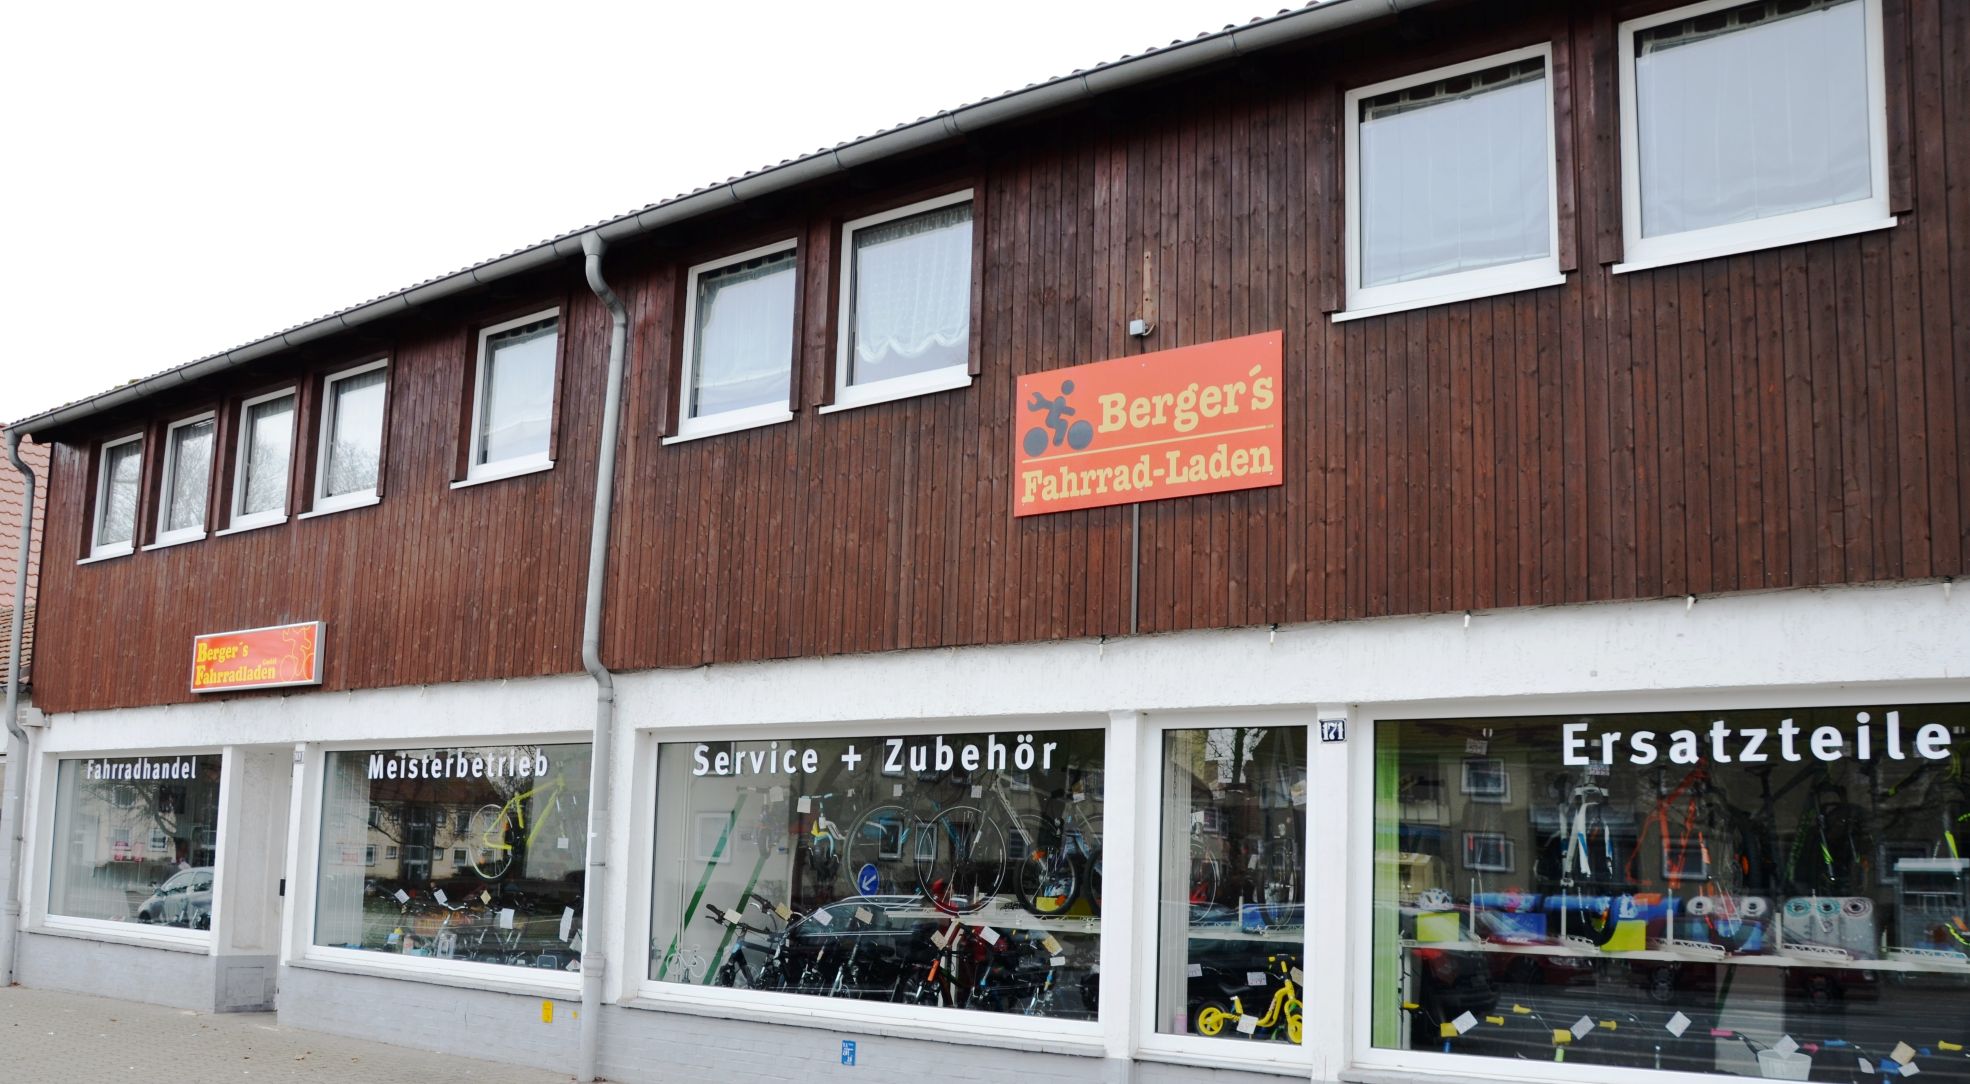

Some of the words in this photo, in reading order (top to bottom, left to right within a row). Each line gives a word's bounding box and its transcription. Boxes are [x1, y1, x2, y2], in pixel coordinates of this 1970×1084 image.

[1021, 443, 1274, 504] Fahrrad-Laden
[195, 664, 276, 686] Fahrradladen
[1322, 721, 1344, 740] 171
[1562, 710, 1952, 767] Ersatzteile
[86, 755, 197, 780] Fahrradhandel
[367, 748, 549, 780] Meisterbetrieb
[692, 741, 819, 776] Service
[840, 744, 863, 772] +
[884, 734, 1058, 773] Zubehör
